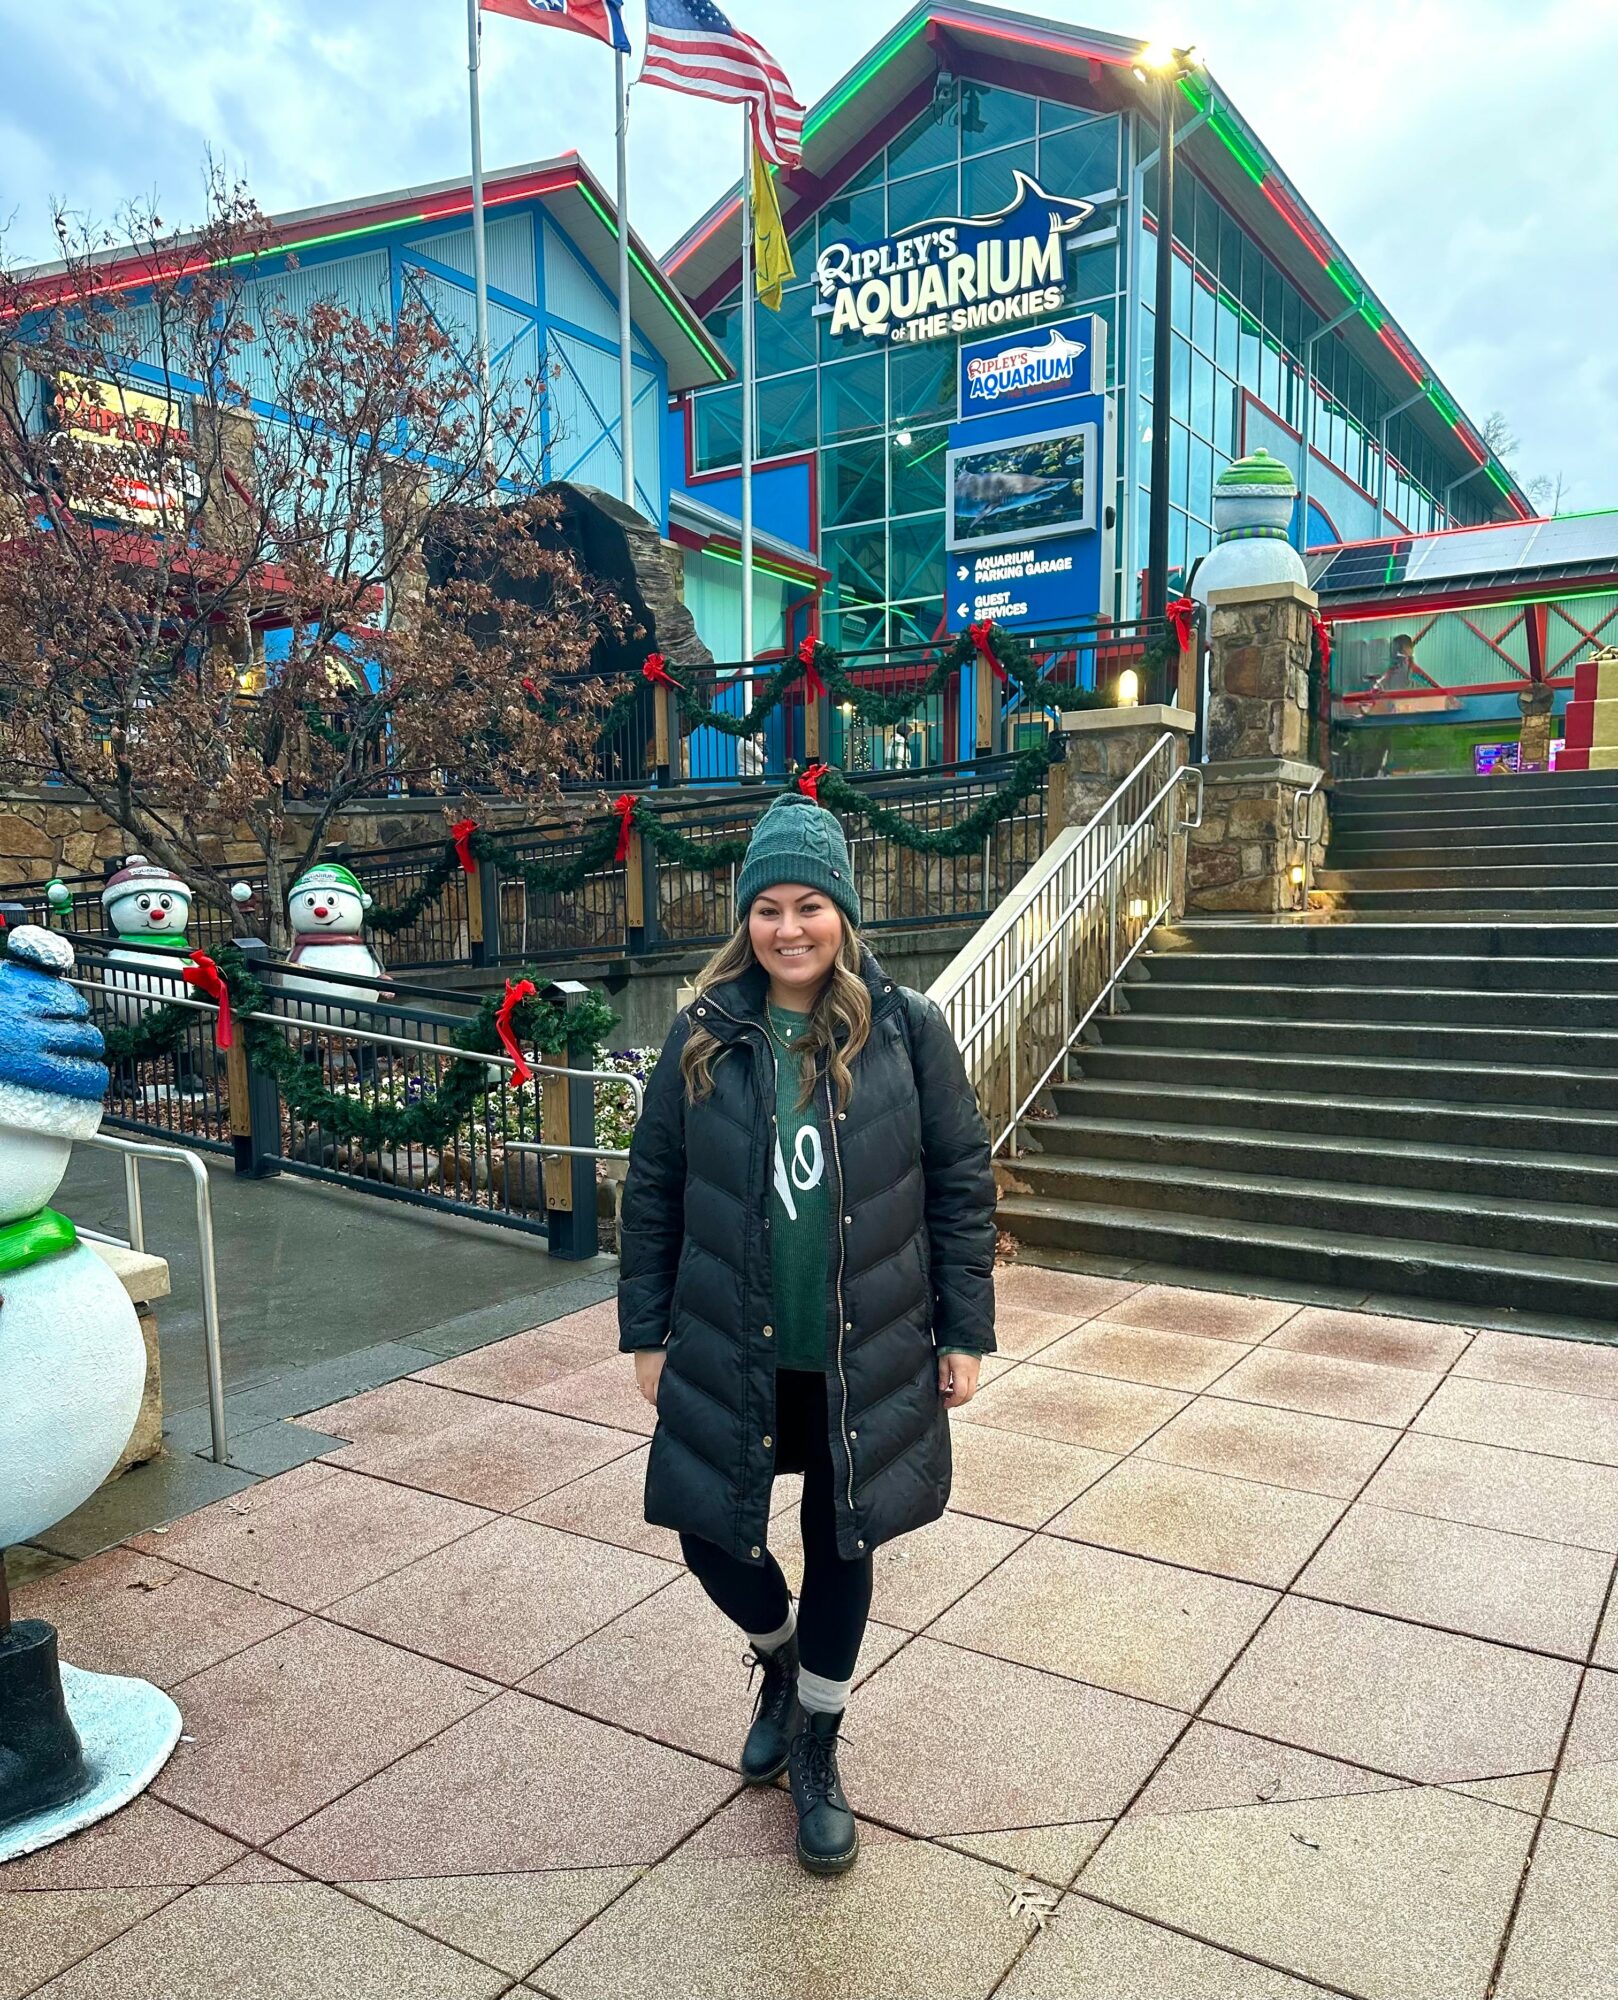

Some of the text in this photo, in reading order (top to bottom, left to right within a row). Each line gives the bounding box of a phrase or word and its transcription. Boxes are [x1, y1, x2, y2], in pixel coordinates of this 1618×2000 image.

[817, 228, 957, 297] RIPLEY'S
[830, 232, 1063, 337] AQUARIUM
[907, 312, 949, 342] THE
[951, 288, 1064, 332] SMOKIES
[968, 353, 1028, 378] RIPLEY'S
[971, 357, 1072, 398] AQUARIUM
[975, 550, 1034, 570] AQUARIUM
[975, 557, 1072, 583] PARKING GARAGE
[974, 602, 1028, 620] SERVICES
[975, 592, 1010, 608] GUEST
